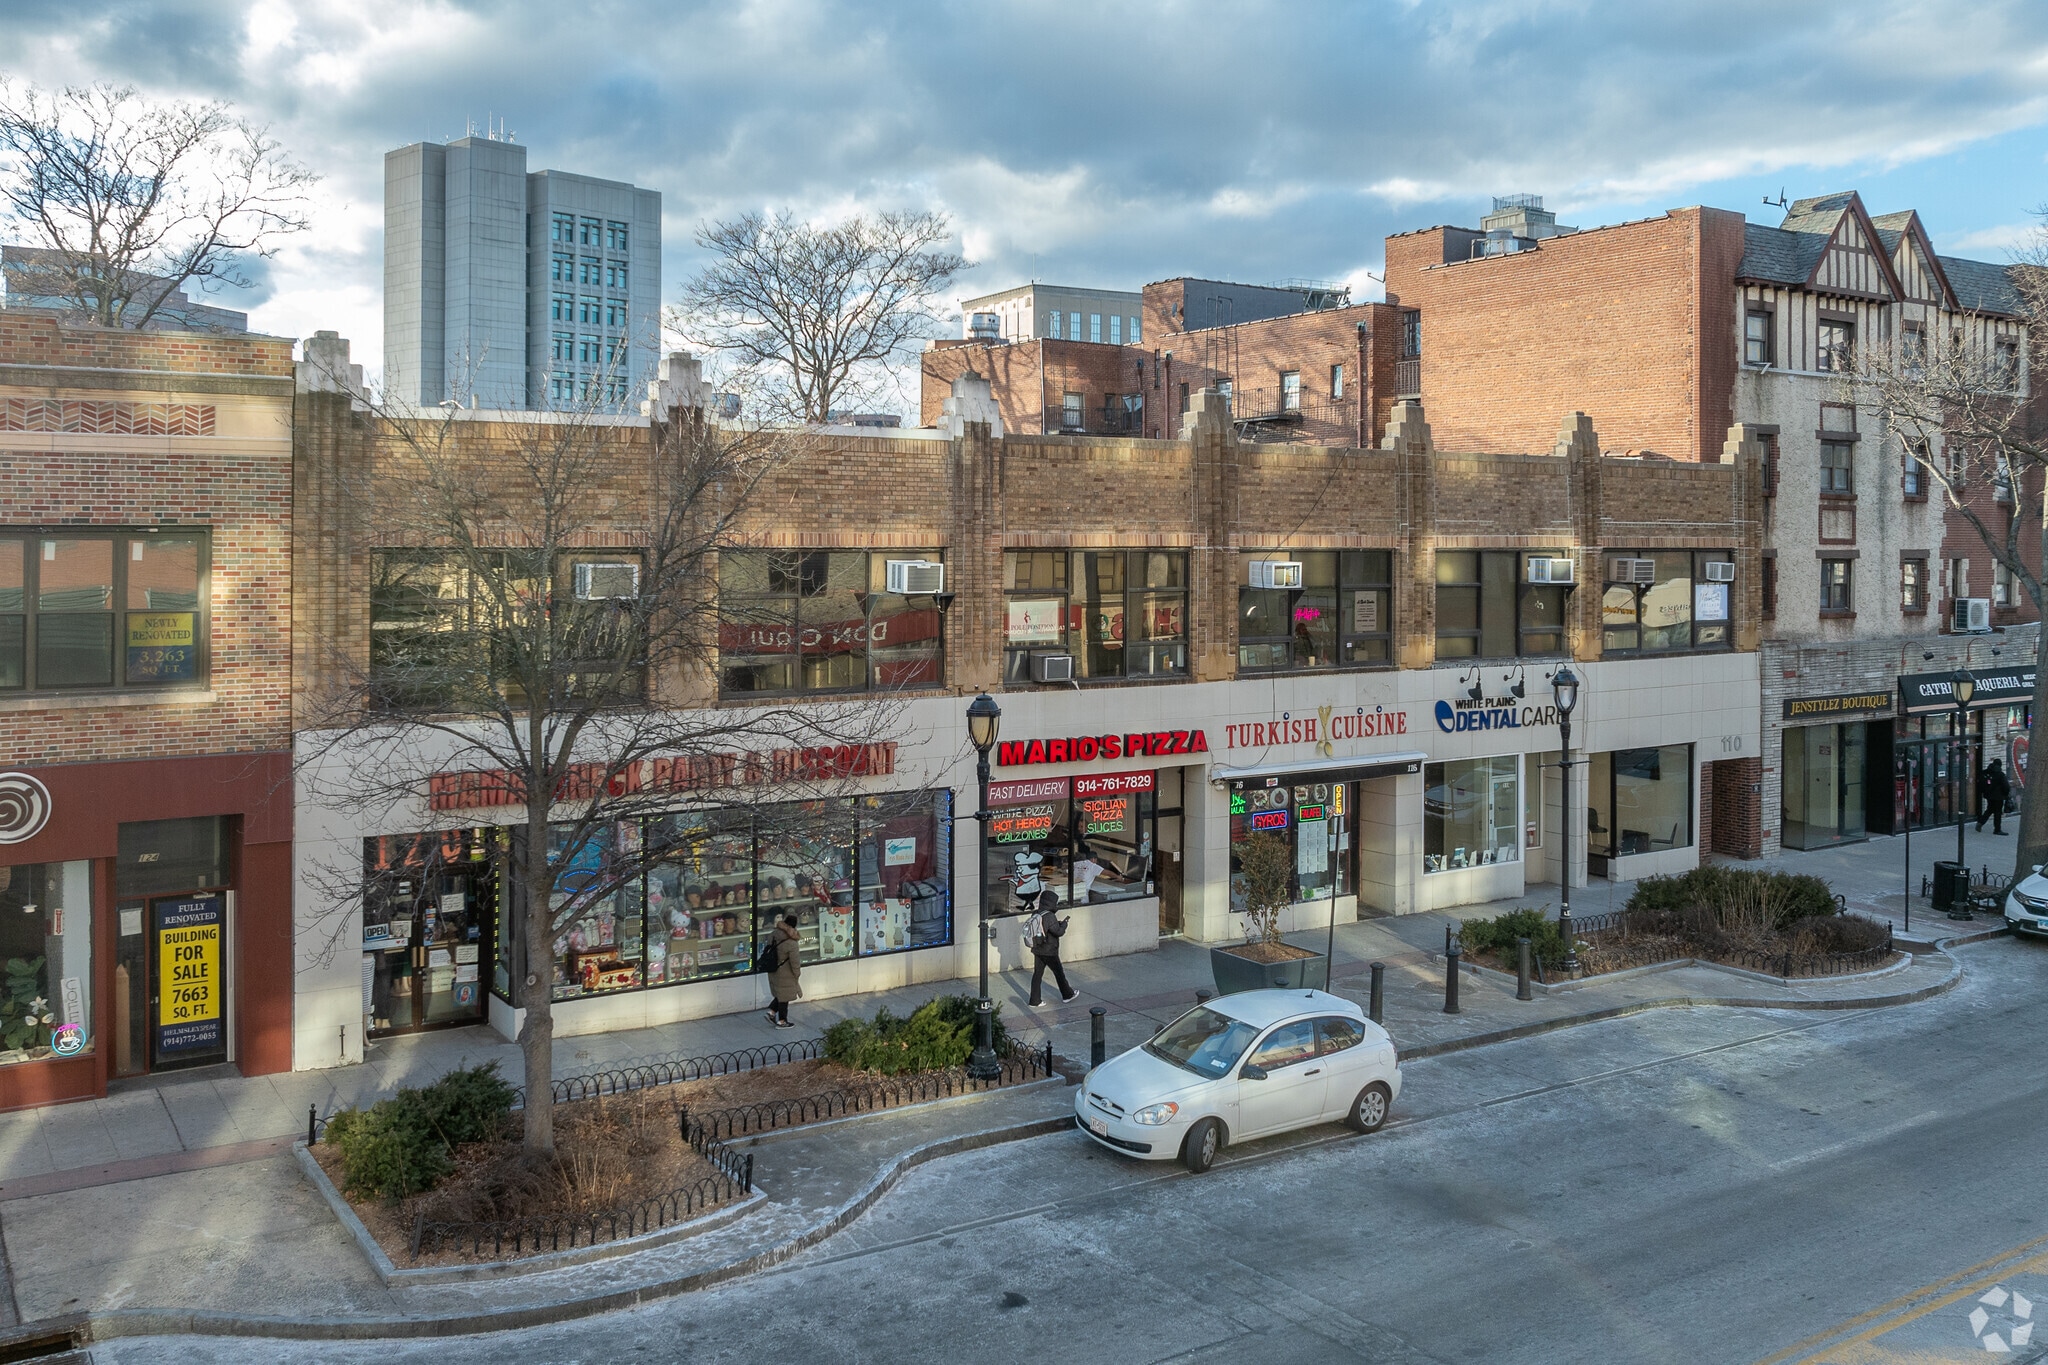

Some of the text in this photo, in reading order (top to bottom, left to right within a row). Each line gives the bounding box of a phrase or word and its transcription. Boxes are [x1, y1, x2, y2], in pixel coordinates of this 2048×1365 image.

[145, 618, 178, 628] NEWLY
[132, 630, 191, 640] RENOVATED
[140, 649, 185, 664] 3,263
[1920, 676, 2021, 696] CATRI AQUERIA
[1455, 697, 1516, 709] WHITE PLAINS
[1790, 694, 1888, 716] JENSTYLEZ BOUTIQUE
[1226, 705, 1407, 748] TURKISH CUISINE
[997, 730, 1209, 767] MARIO'S PIZZA
[1721, 735, 1741, 752] 110
[772, 742, 898, 784] DISCOUNT
[989, 781, 1064, 800] FAST DELIVERY
[1077, 775, 1151, 793] 914-761-7829
[1084, 799, 1127, 812] SICILIAN
[1335, 785, 1343, 815] OPEN
[1025, 804, 1053, 817] PIZZA
[1093, 809, 1124, 822] PIZZA
[1301, 807, 1322, 818] FALAFEL
[993, 816, 1051, 832] HOT HERO'S
[1087, 821, 1124, 833] SLICES
[1253, 812, 1286, 829] GYROS
[997, 828, 1048, 843] CALZONES
[178, 903, 205, 913] FULLY
[165, 912, 216, 924] RENOVATED
[165, 929, 216, 944] BUILDING
[366, 925, 387, 937] OPEN
[175, 945, 203, 962] FOR
[173, 963, 208, 981] SALE
[65, 979, 80, 1023] COFF
[173, 986, 208, 1003] 7663
[173, 1004, 208, 1018] SQ. FT.
[163, 1032, 216, 1047] (914)772-0055
